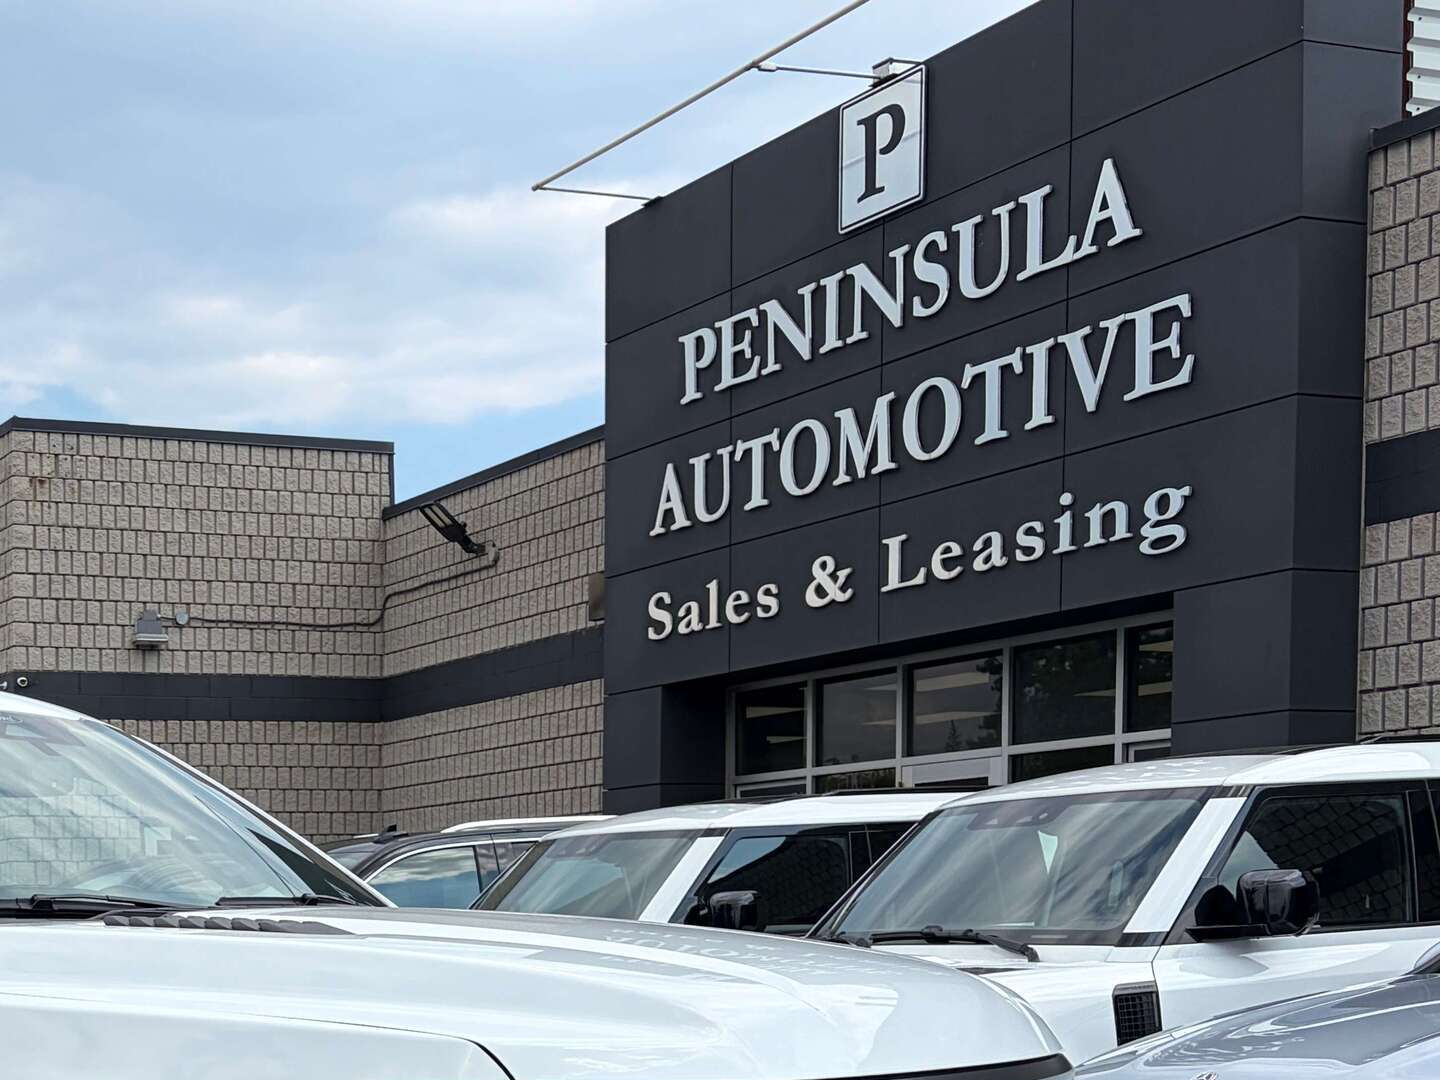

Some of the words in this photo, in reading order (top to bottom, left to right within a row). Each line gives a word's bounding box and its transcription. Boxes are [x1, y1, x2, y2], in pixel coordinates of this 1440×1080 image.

[857, 103, 906, 204] P
[679, 157, 1143, 404] PENINSULA
[649, 293, 1196, 537] AUTOMOTIVE
[647, 579, 780, 641] Sales
[805, 554, 854, 608] &
[880, 485, 1193, 593] Leasing
